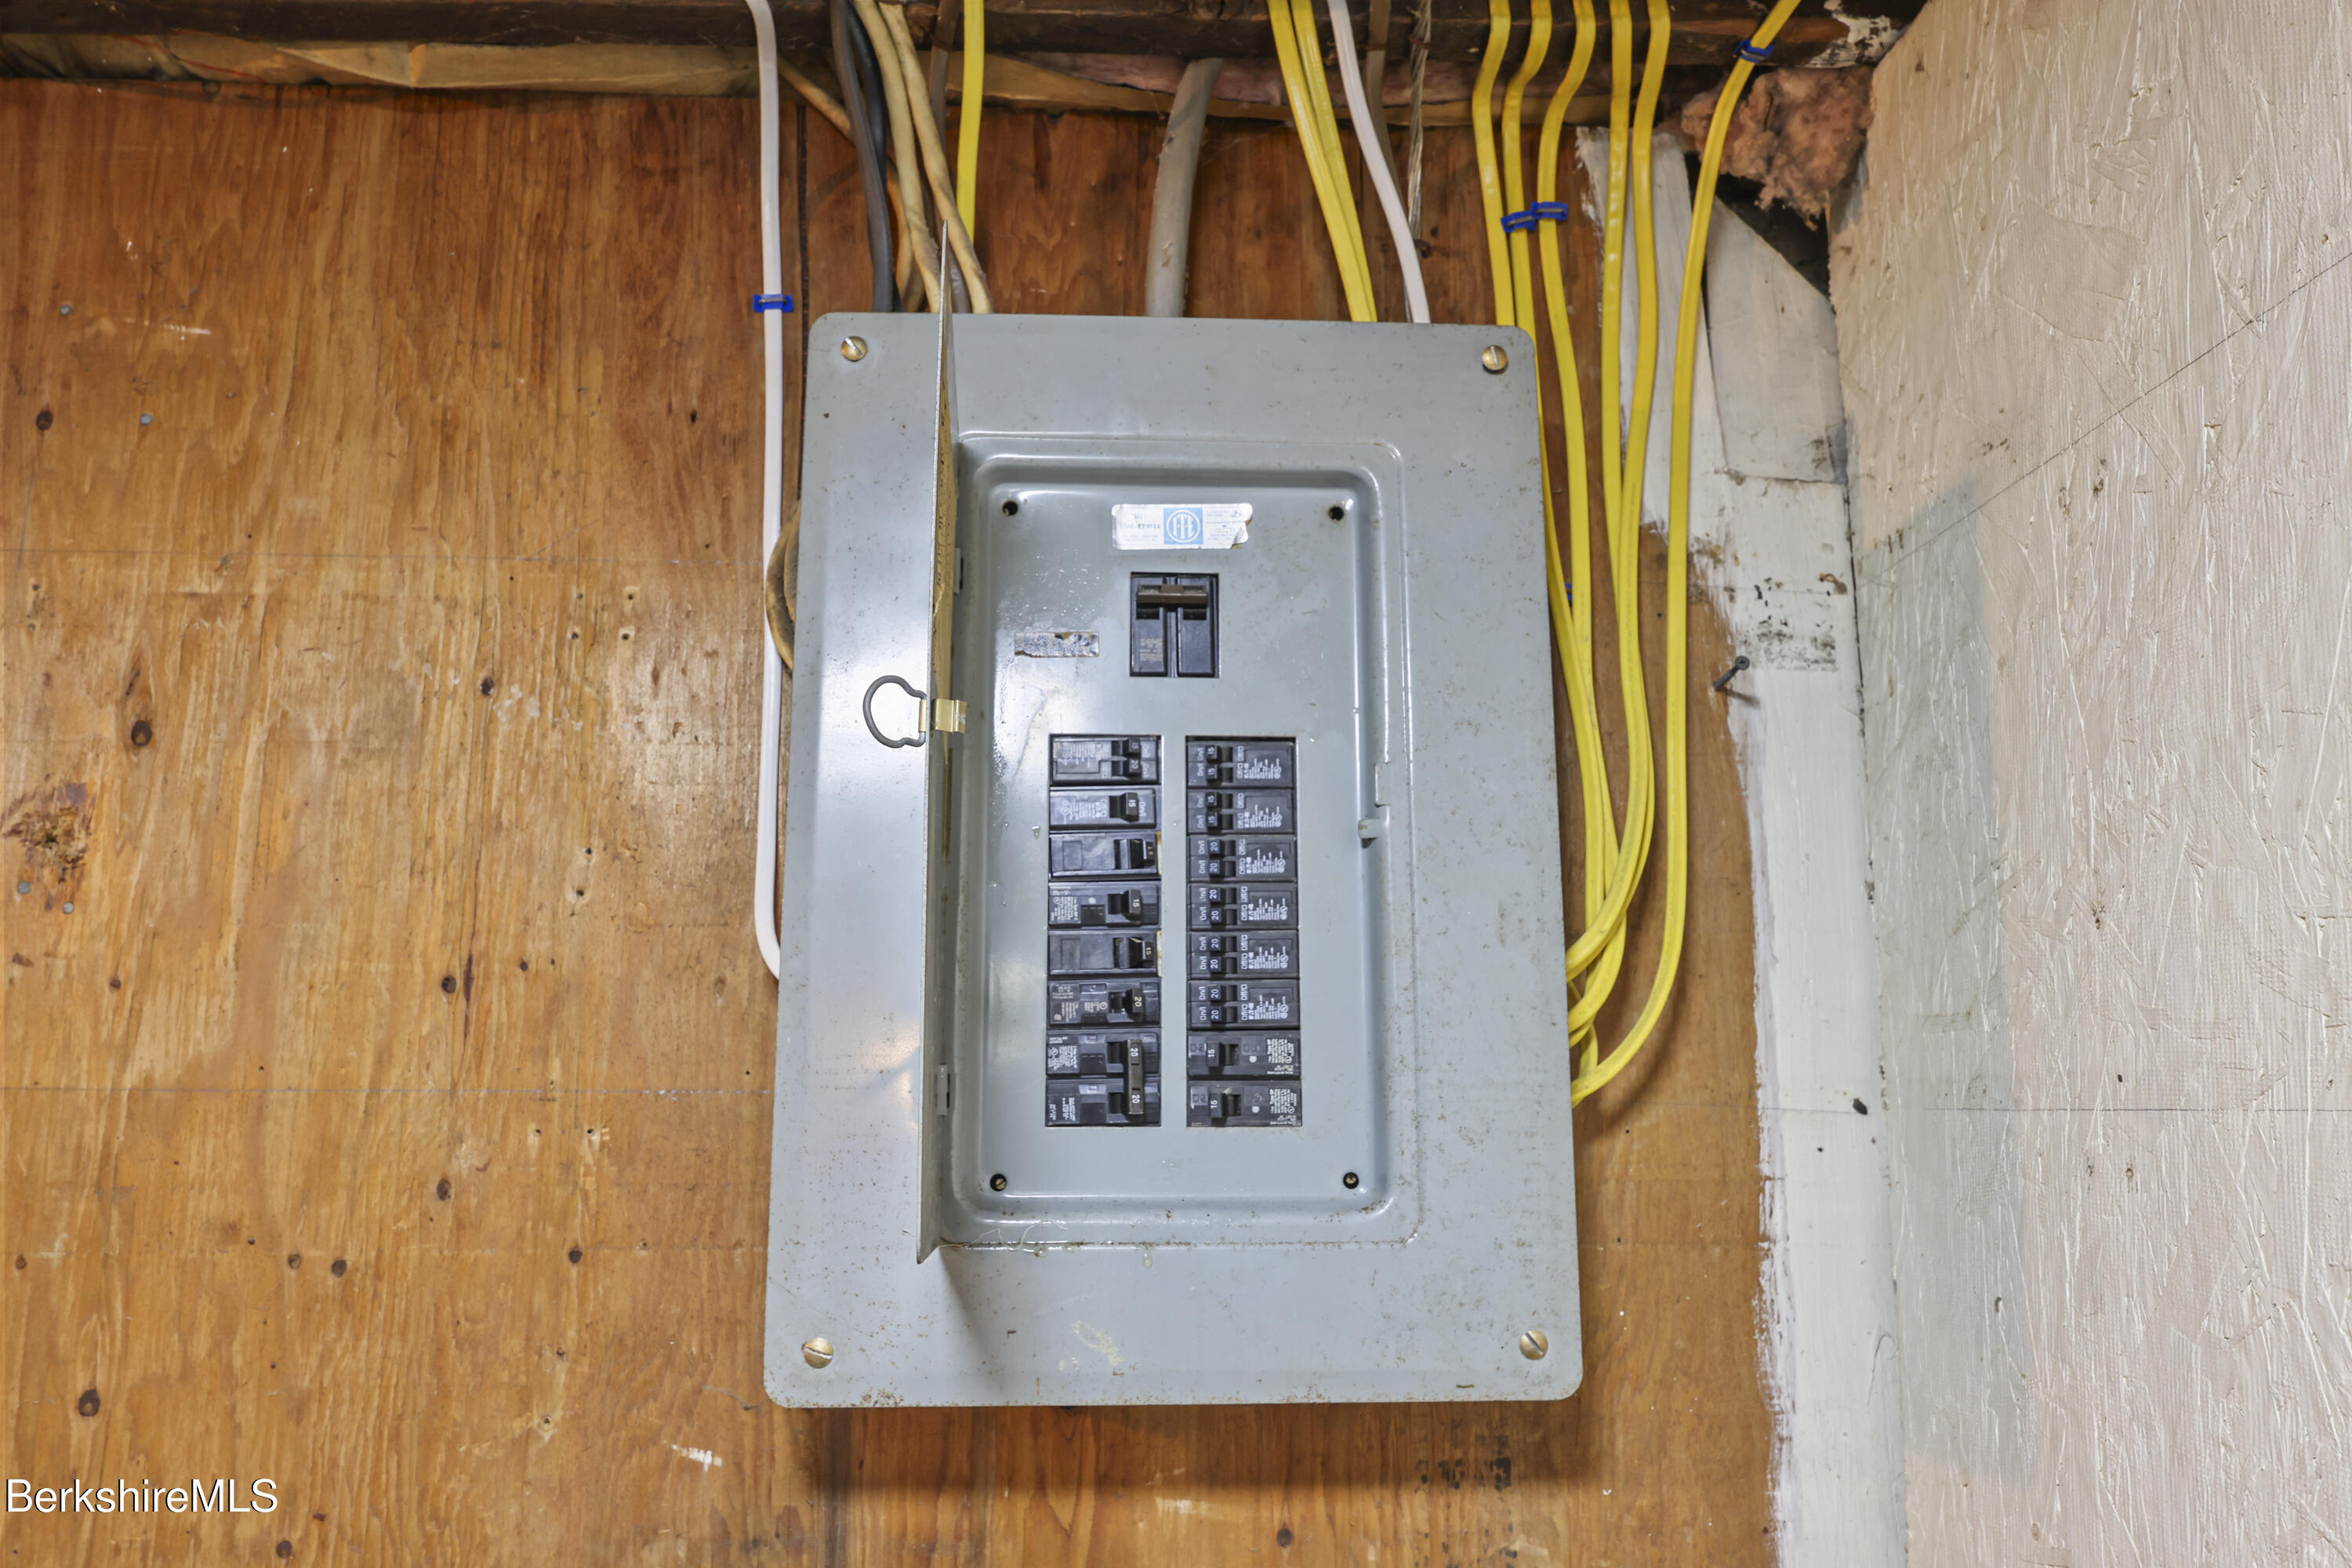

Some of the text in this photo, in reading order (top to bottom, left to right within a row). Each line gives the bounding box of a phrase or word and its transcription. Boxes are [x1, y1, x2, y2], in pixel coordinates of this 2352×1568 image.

[1131, 760, 1138, 768] 20
[1208, 768, 1214, 776] 15
[1210, 842, 1218, 851] 20
[1210, 863, 1218, 872] 20
[1210, 889, 1217, 899] 20
[1133, 898, 1139, 908] 15
[1212, 911, 1219, 920] 20
[1211, 938, 1218, 948] 20
[1146, 947, 1151, 956] 15
[1210, 960, 1218, 968] 20
[1211, 989, 1218, 998] 20
[1134, 996, 1142, 1007] 20
[1212, 1010, 1218, 1019] 20
[1131, 1048, 1138, 1057] 20
[1132, 1094, 1139, 1103] 20
